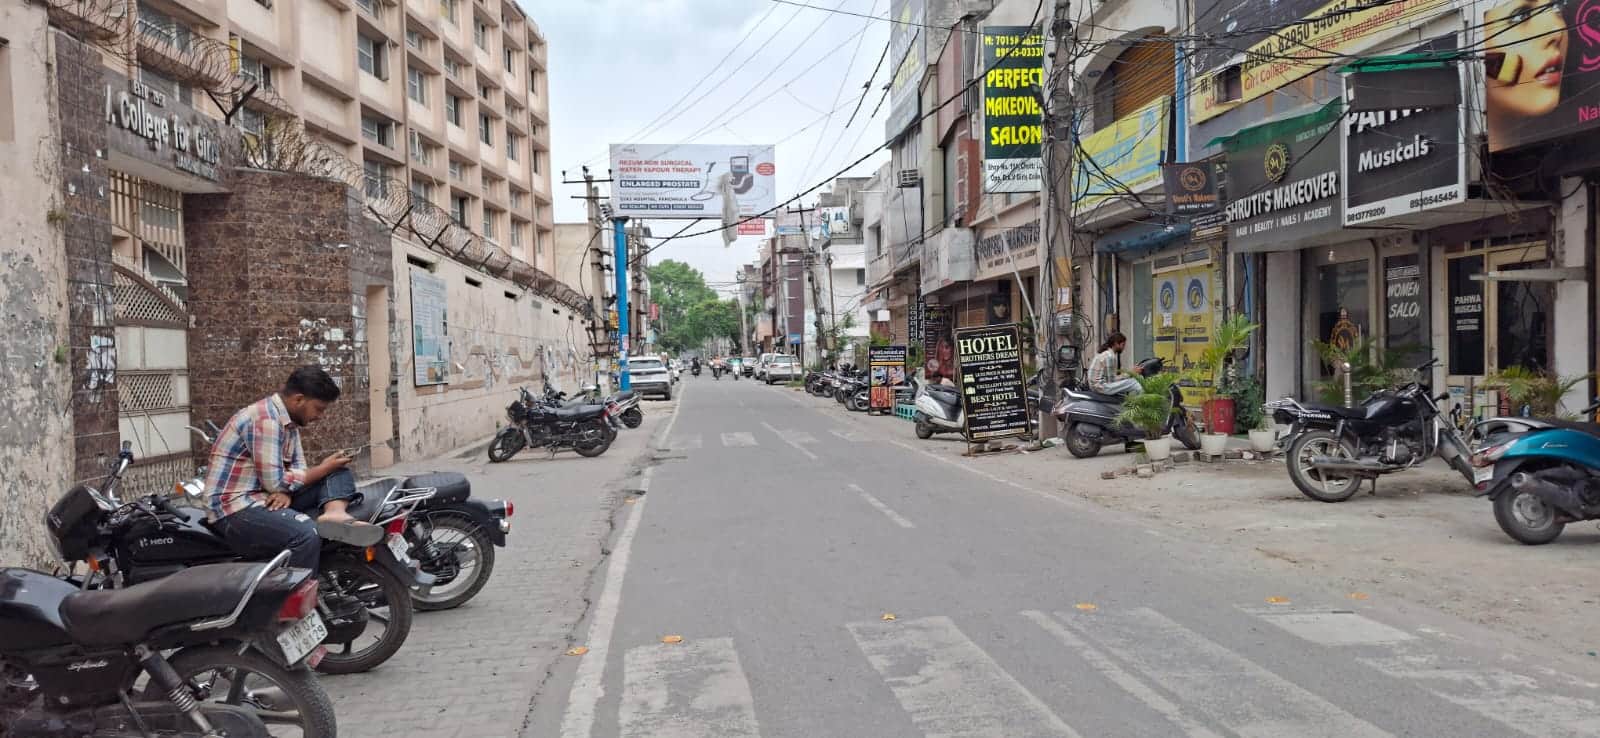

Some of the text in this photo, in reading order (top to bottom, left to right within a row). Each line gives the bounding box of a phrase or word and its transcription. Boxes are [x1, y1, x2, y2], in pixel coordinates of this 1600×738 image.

[986, 95, 1043, 117] MAKEOVE
[119, 91, 169, 151] College
[174, 114, 190, 152] for
[990, 125, 1042, 147] SALON
[1358, 134, 1430, 173] Musicals
[1225, 171, 1337, 223] SHRUTI'S MAKEOVER
[1254, 219, 1274, 233] BEAUTY
[1281, 213, 1297, 226] NAILS
[1304, 205, 1332, 222] ACADEMY
[1387, 281, 1420, 298] WOMEN
[1454, 294, 1481, 305] PAHWA
[959, 335, 1018, 355] HOTEL
[961, 353, 995, 363] BROTHERS
[996, 350, 1018, 360] DREAM
[970, 392, 1018, 404] BEST HOTEL
[150, 536, 174, 546] Hero
